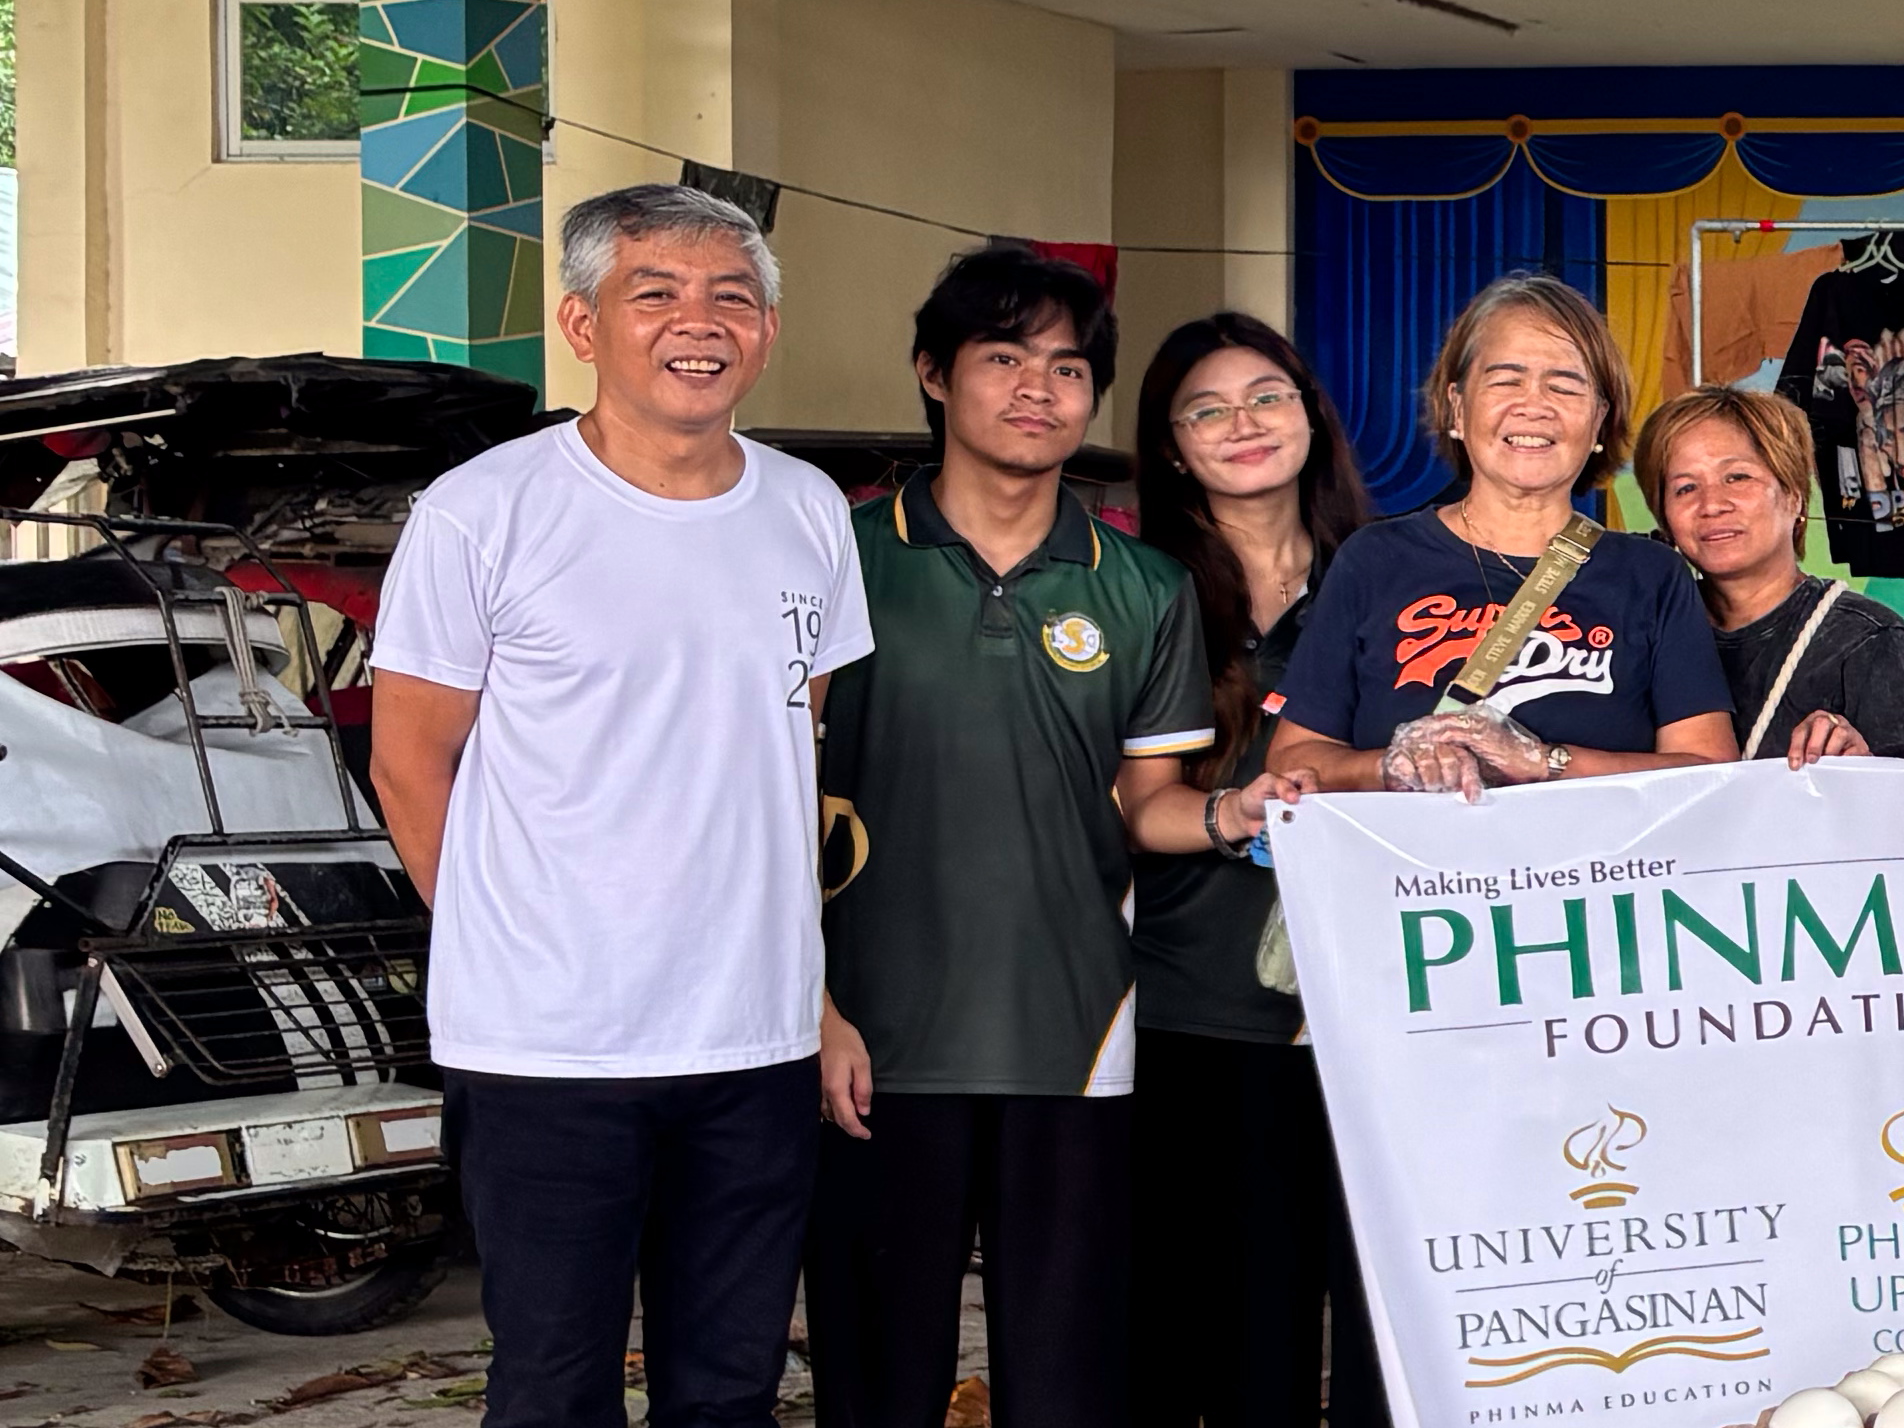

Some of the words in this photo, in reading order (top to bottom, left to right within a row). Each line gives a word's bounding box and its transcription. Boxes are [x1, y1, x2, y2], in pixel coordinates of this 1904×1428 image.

[782, 606, 821, 657] 19
[787, 659, 814, 710] 2
[1394, 871, 1500, 901] Making
[1509, 866, 1581, 891] Lives
[1590, 856, 1677, 883] Better
[1424, 1203, 1787, 1274] UNIVERSITY
[1595, 1259, 1624, 1294] of
[1456, 1283, 1769, 1350] PANGASINAN
[1469, 1398, 1585, 1425] PHINMA
[1604, 1378, 1774, 1410] EDUCATION
